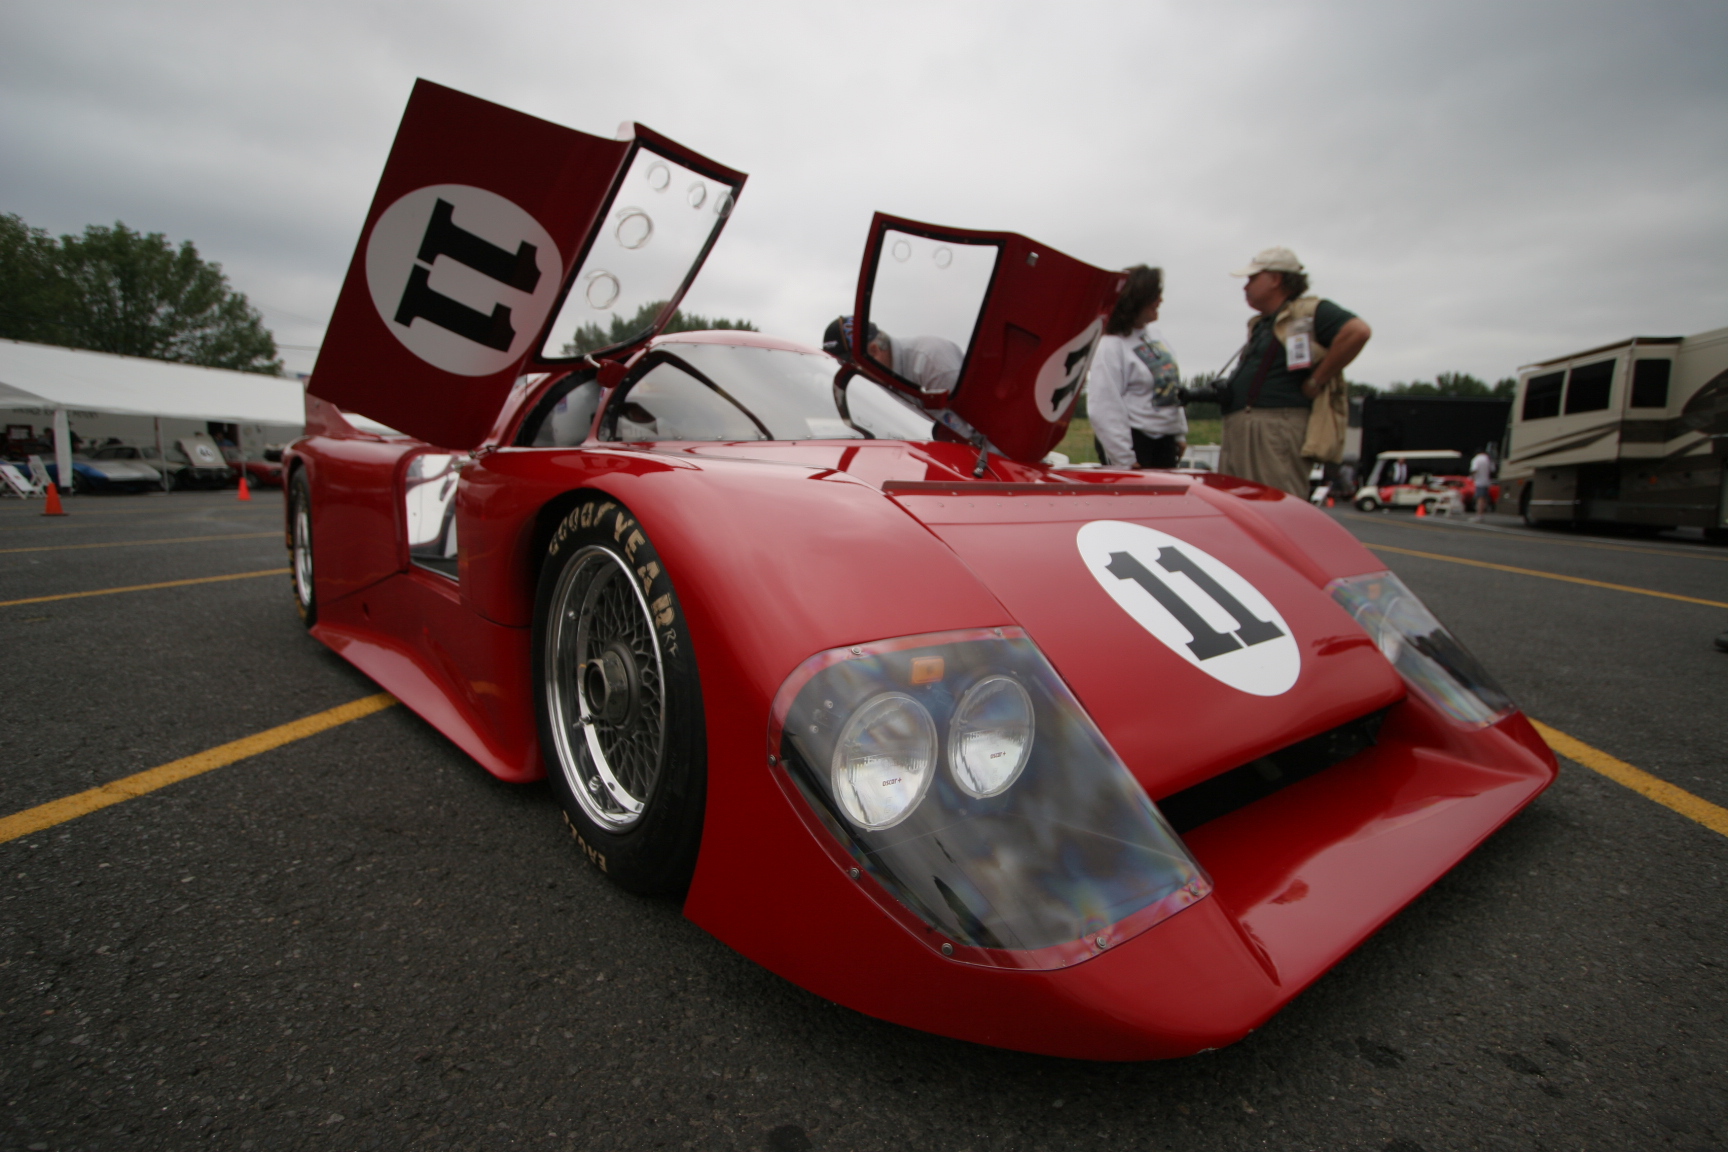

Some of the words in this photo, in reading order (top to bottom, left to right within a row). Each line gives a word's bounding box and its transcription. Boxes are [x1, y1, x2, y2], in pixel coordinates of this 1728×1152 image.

[394, 196, 542, 354] 11
[548, 501, 675, 629] GOODYEAR
[1104, 545, 1286, 662] 11
